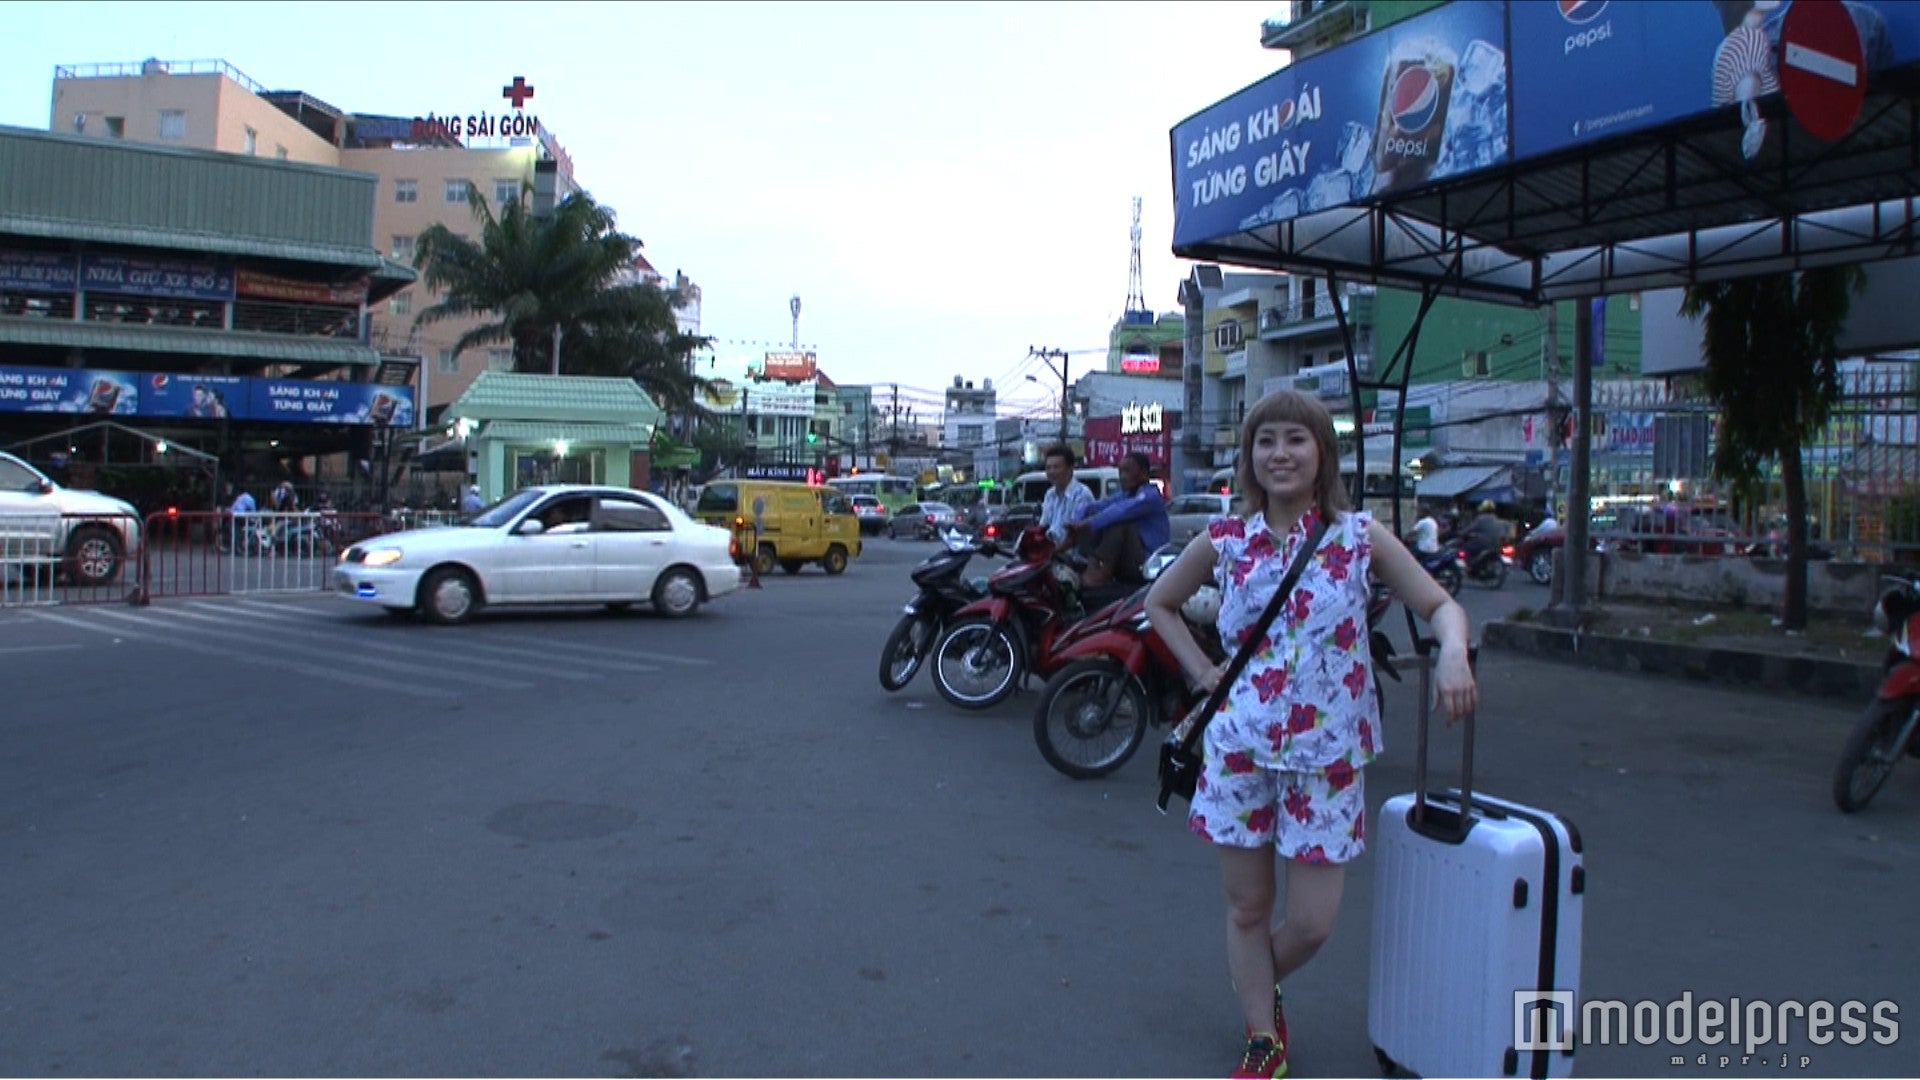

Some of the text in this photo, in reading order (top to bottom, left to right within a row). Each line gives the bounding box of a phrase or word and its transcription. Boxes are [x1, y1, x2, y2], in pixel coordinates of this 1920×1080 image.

[1564, 19, 1611, 55] pepsi
[466, 110, 495, 136] SÀI
[500, 110, 538, 136] GÒN
[1187, 121, 1241, 168] SẢNG
[1384, 137, 1428, 159] pepsi
[1192, 140, 1310, 207] TỪNG GIÂY
[164, 273, 187, 288] XE
[219, 277, 231, 291] 2
